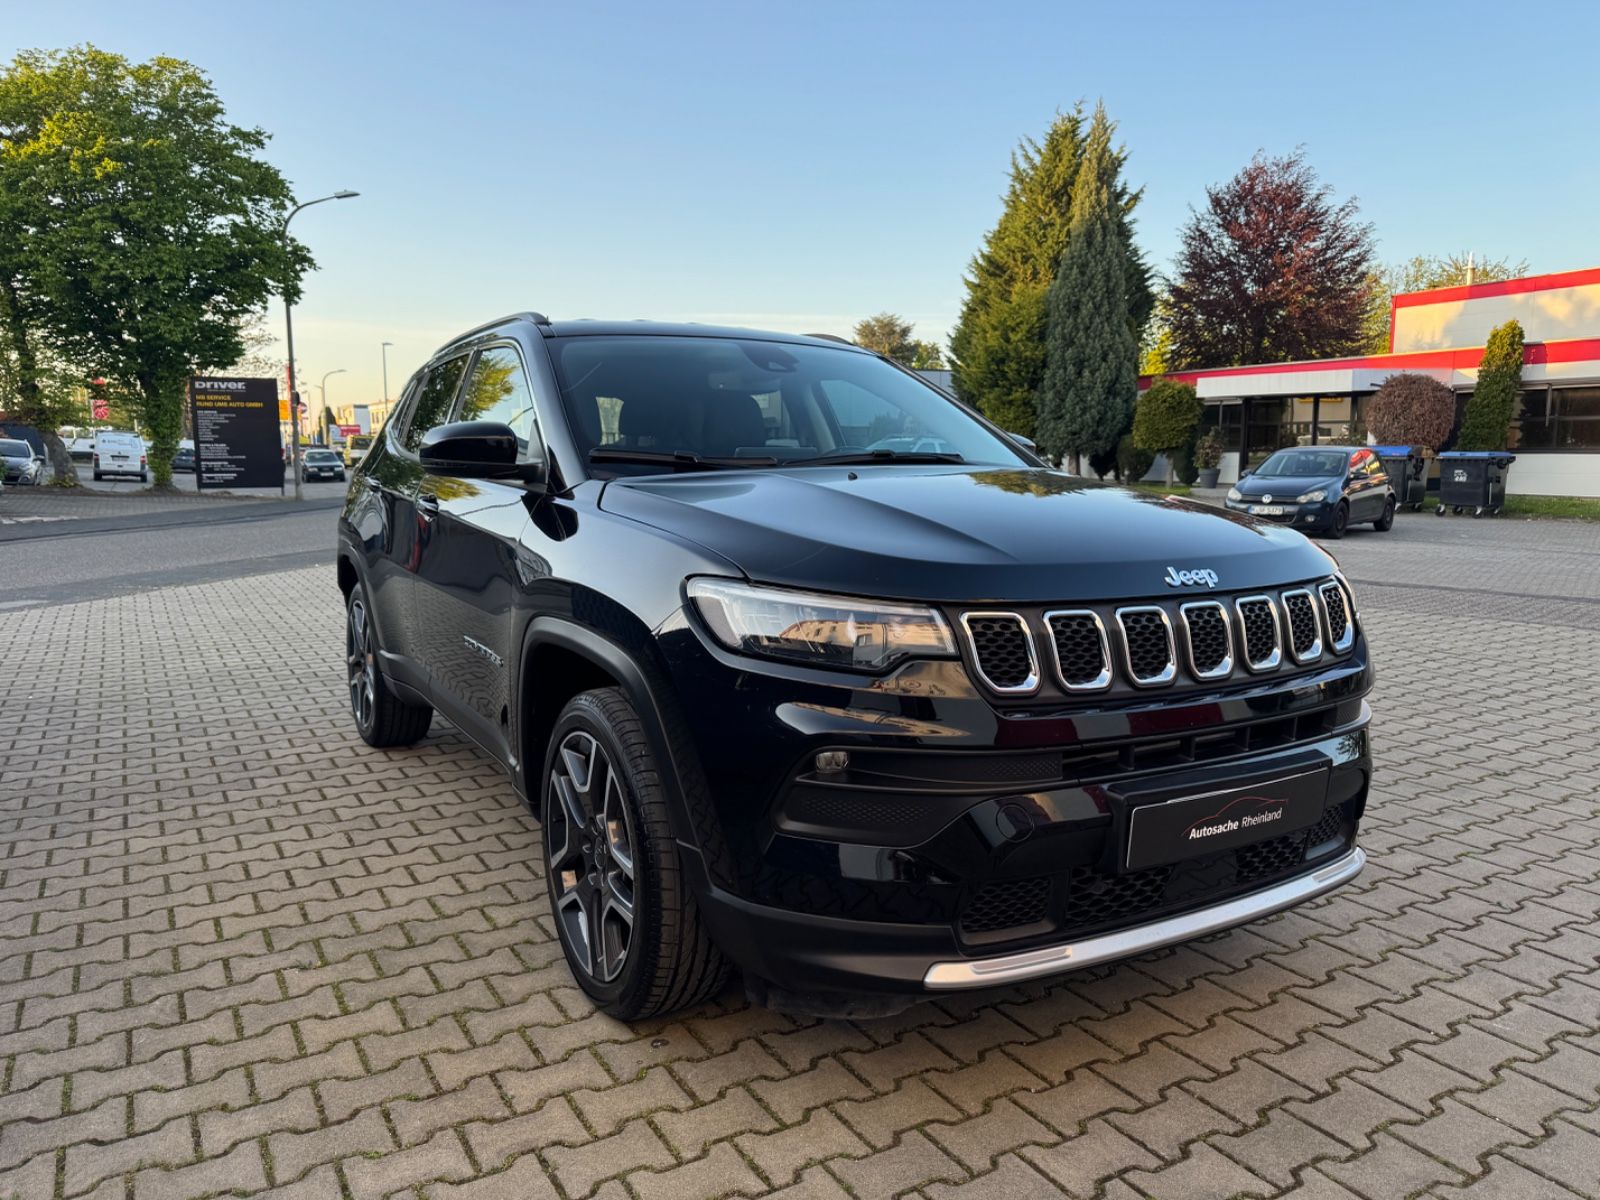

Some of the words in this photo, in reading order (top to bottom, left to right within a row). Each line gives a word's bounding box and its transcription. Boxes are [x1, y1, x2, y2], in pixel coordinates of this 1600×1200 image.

[1164, 566, 1219, 589] Jeep
[1188, 819, 1239, 840] Autosache
[1241, 806, 1283, 828] Rheinland
